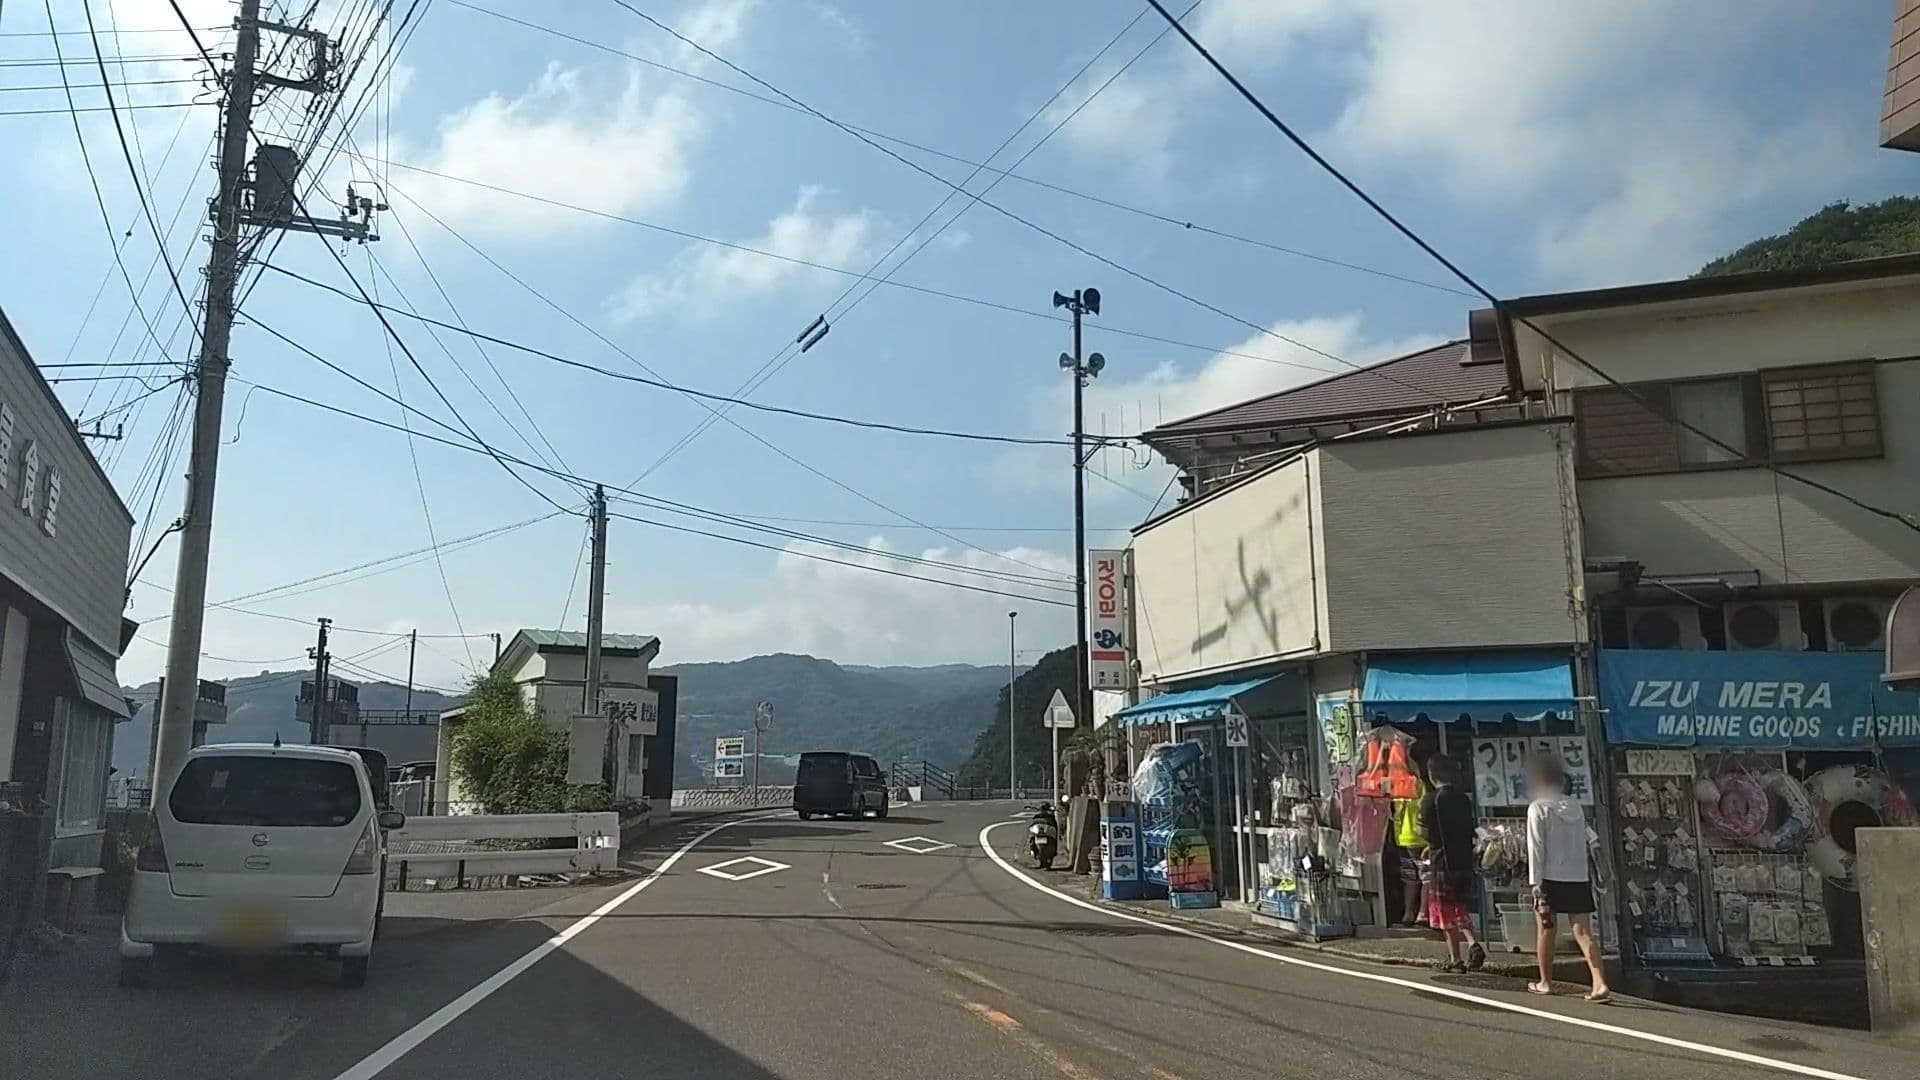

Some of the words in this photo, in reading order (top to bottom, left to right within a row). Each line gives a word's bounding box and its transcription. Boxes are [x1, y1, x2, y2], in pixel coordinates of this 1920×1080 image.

[1098, 559, 1116, 618] RYOBI
[1628, 680, 1699, 708] IZU
[1718, 681, 1833, 709] MERA
[1227, 718, 1247, 742] 氷
[1657, 714, 1743, 737] MARINE
[1750, 715, 1822, 738] GOODS
